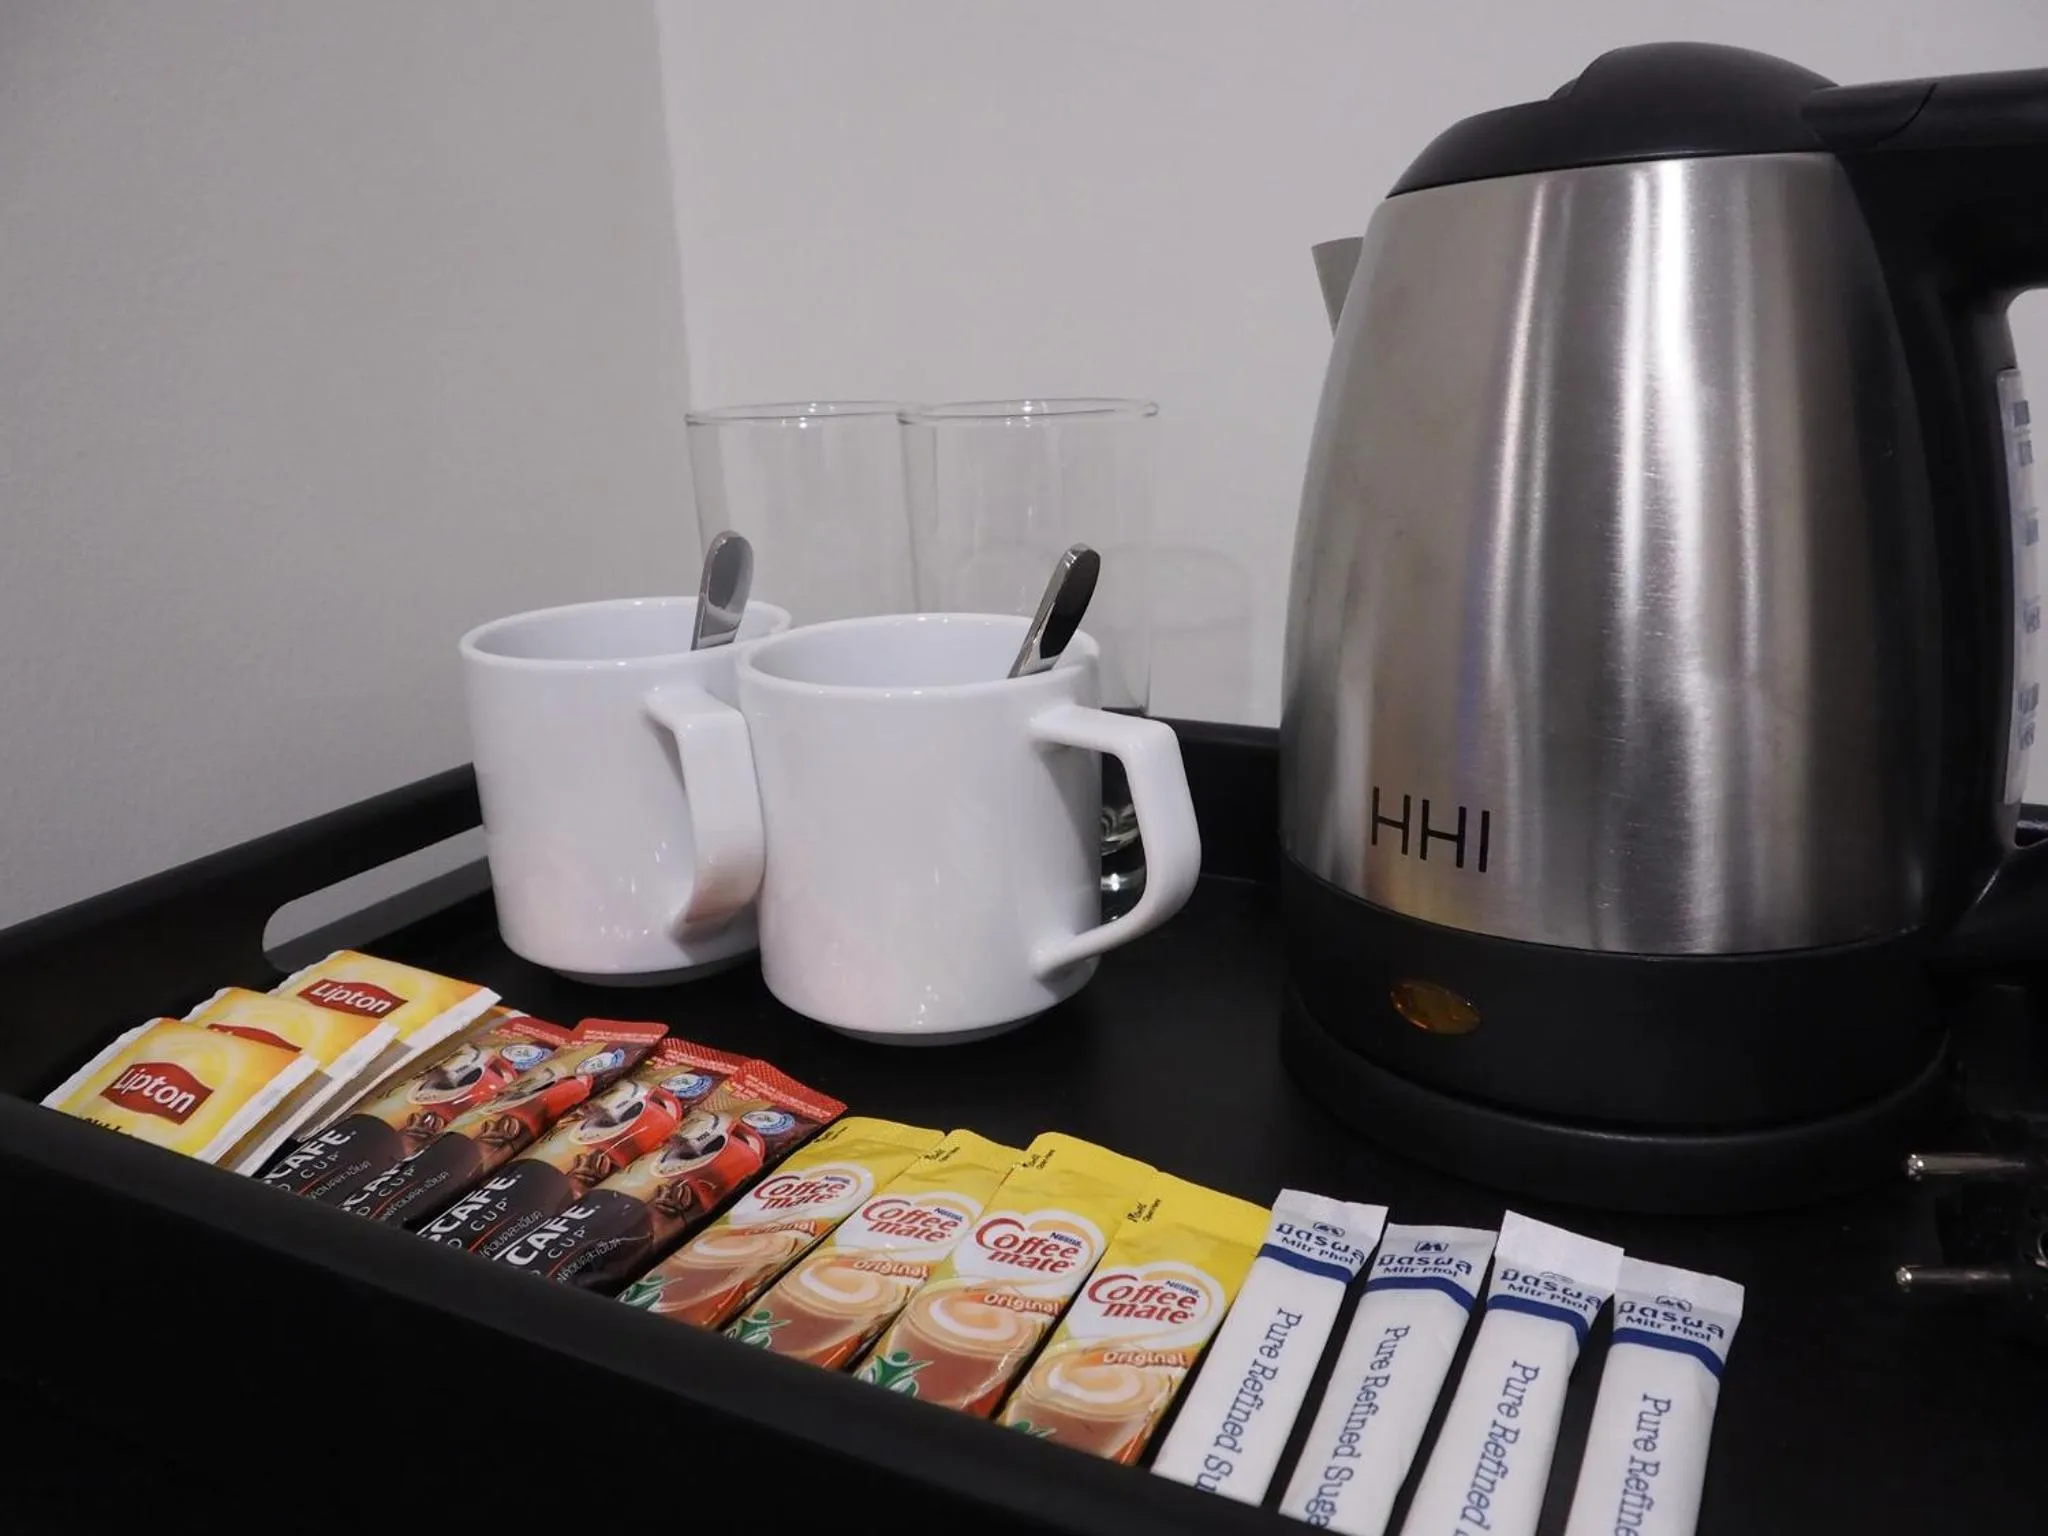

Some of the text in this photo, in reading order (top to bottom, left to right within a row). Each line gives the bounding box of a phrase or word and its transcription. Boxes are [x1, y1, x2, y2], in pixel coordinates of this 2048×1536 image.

[1371, 786, 1490, 873] HHI
[310, 982, 393, 1014] Lipton
[111, 1067, 196, 1114] Lipton
[264, 1130, 351, 1181] CAFE
[753, 1175, 847, 1200] Coffee
[430, 1177, 517, 1234] CAFE
[471, 1199, 507, 1230] CUP
[862, 1199, 959, 1230] Coffee
[548, 1227, 585, 1258] CUP
[867, 1221, 946, 1242] mate
[975, 1217, 1080, 1259] Coffee
[987, 1250, 1070, 1273] mate
[1281, 1236, 1354, 1264] Mitr Phol
[1088, 1274, 1198, 1309] Coffee
[1507, 1283, 1588, 1312] Mitr Phol
[1102, 1303, 1190, 1324] mate
[1625, 1314, 1711, 1342] Mitr Phol
[1259, 1307, 1303, 1359] Pure
[1370, 1325, 1411, 1371] Pure
[1213, 1358, 1278, 1454] Refined
[1332, 1374, 1391, 1460] Refined
[1633, 1393, 1672, 1453] Pure
[1460, 1360, 1541, 1531] Pure Refined
